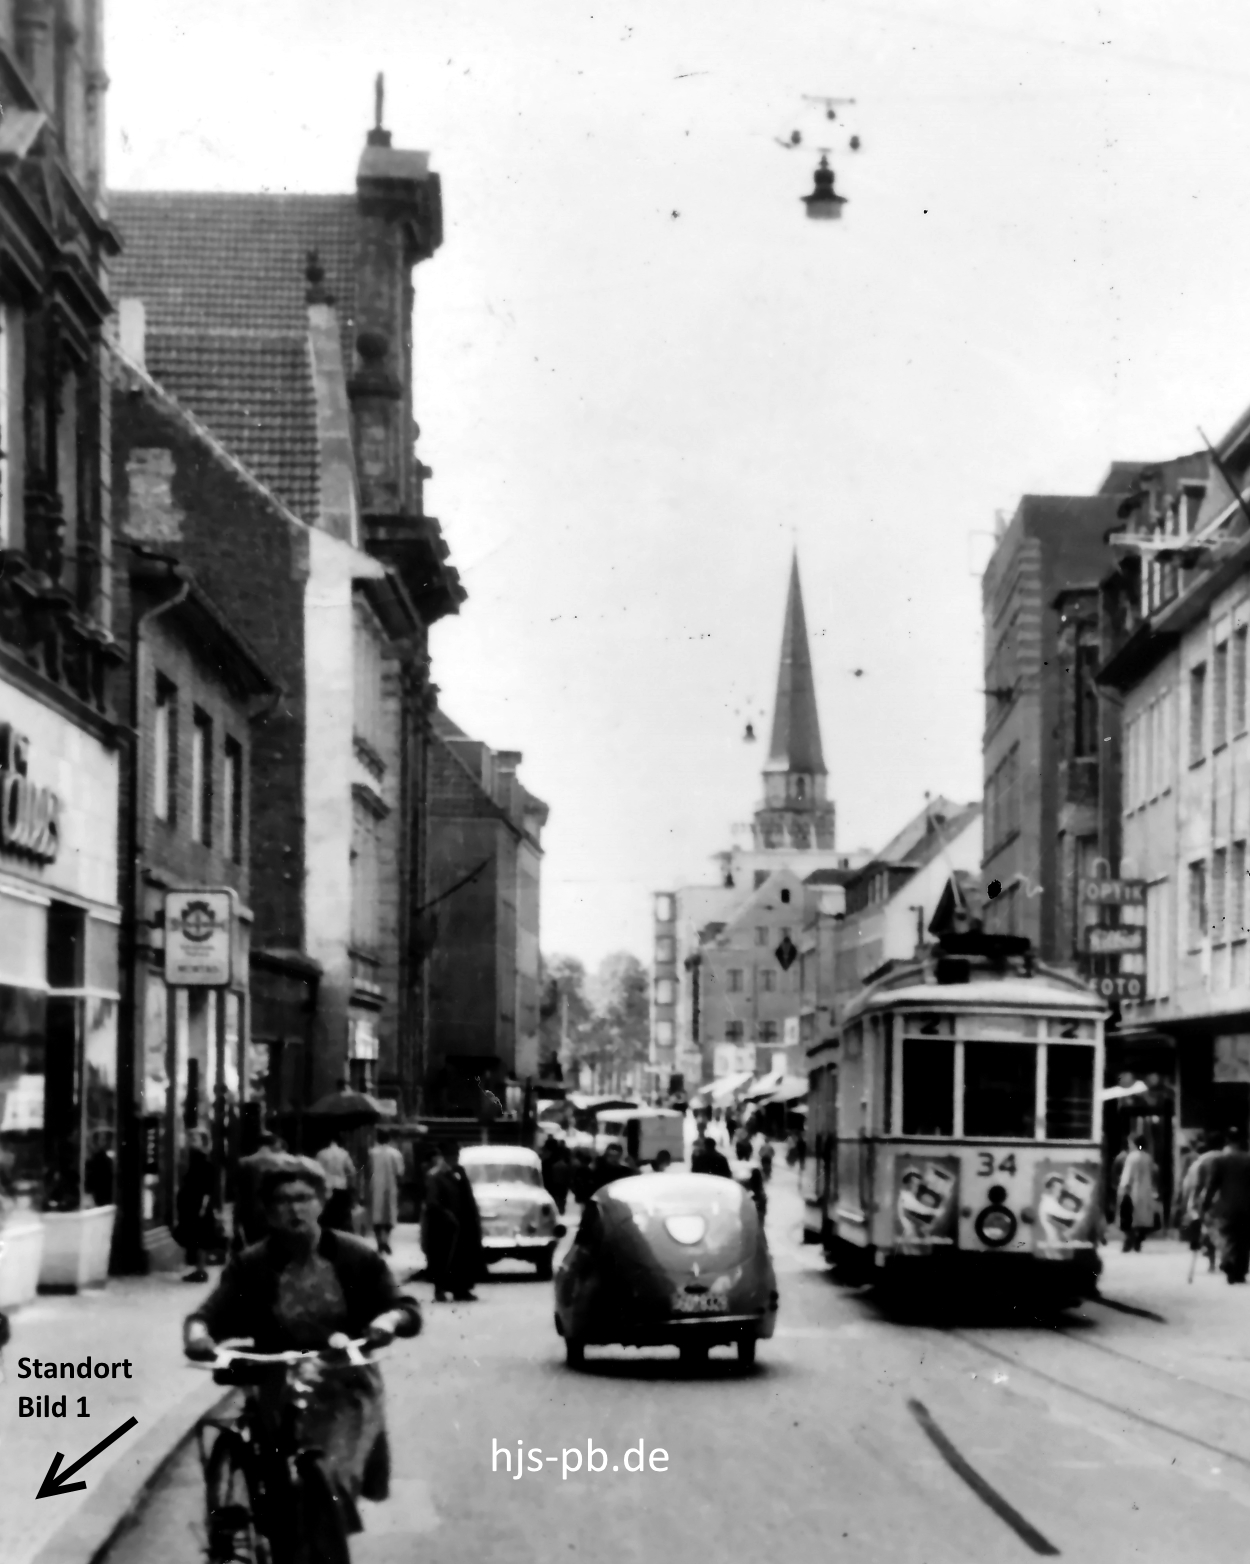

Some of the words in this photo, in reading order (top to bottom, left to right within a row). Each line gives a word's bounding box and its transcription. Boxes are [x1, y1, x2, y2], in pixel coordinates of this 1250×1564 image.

[1086, 882, 1142, 900] OPTIK
[1088, 977, 1141, 996] FOTO
[919, 1014, 941, 1036] 2
[1060, 1018, 1080, 1040] 2
[976, 1151, 1017, 1177] 34
